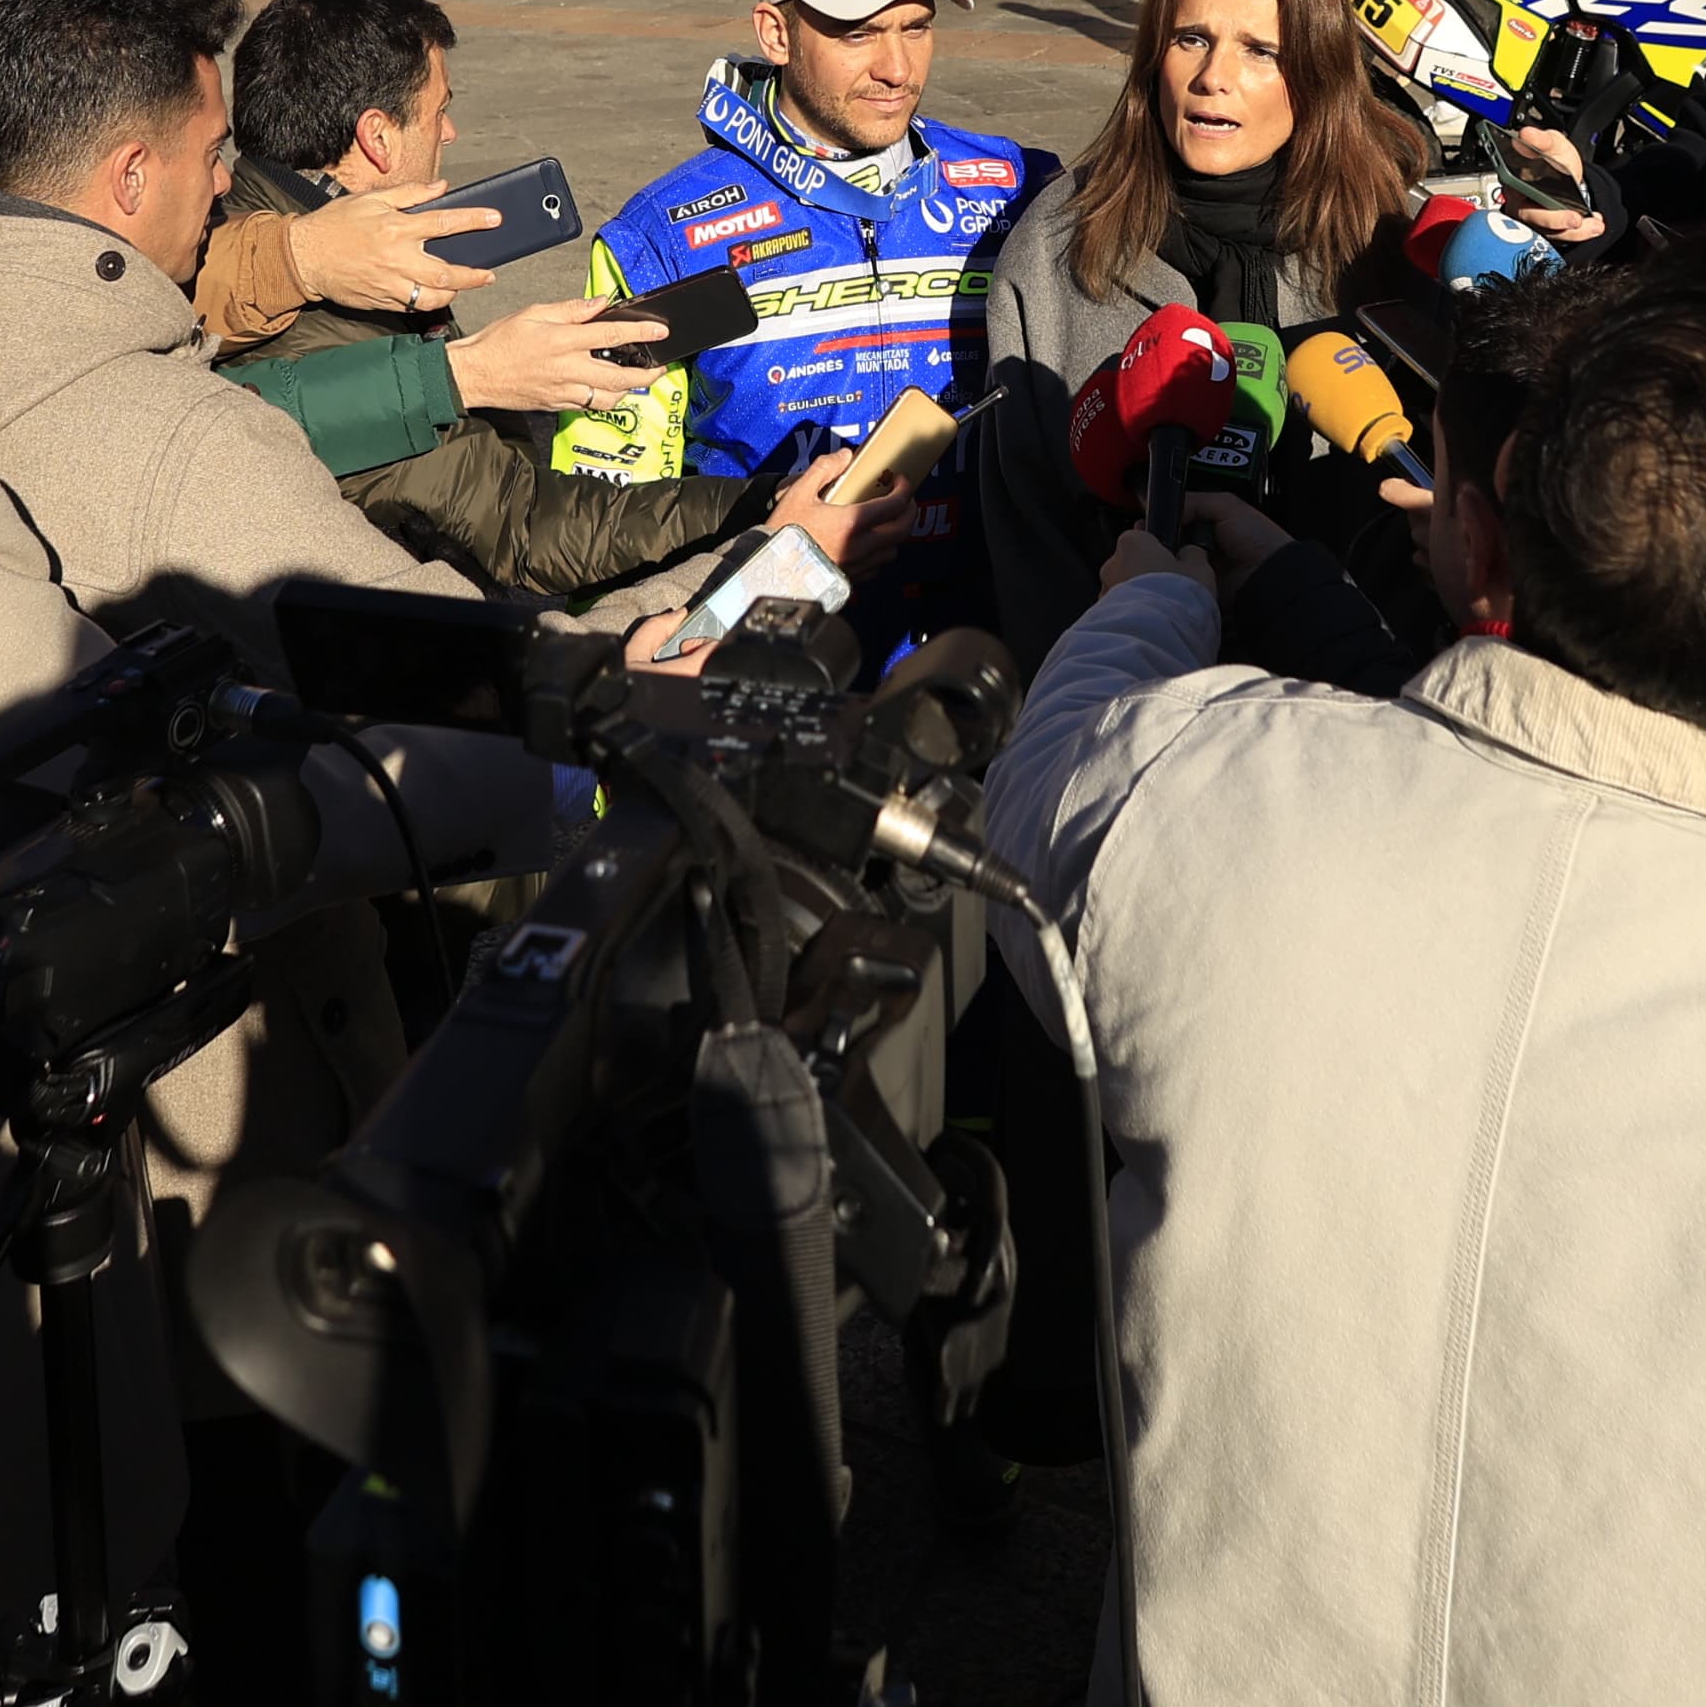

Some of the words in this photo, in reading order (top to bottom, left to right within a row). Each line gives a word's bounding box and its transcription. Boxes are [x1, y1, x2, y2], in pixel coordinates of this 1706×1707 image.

[1433, 64, 1456, 77] TVS
[723, 106, 777, 161] PONT
[772, 146, 826, 195] GRUP
[947, 163, 1009, 178] BS
[676, 189, 741, 219] AIROH
[956, 198, 1008, 217] PONT
[693, 207, 776, 245] MOTUL
[959, 216, 1012, 234] GRUP
[749, 270, 994, 319] SHERCO
[1074, 399, 1105, 452] press
